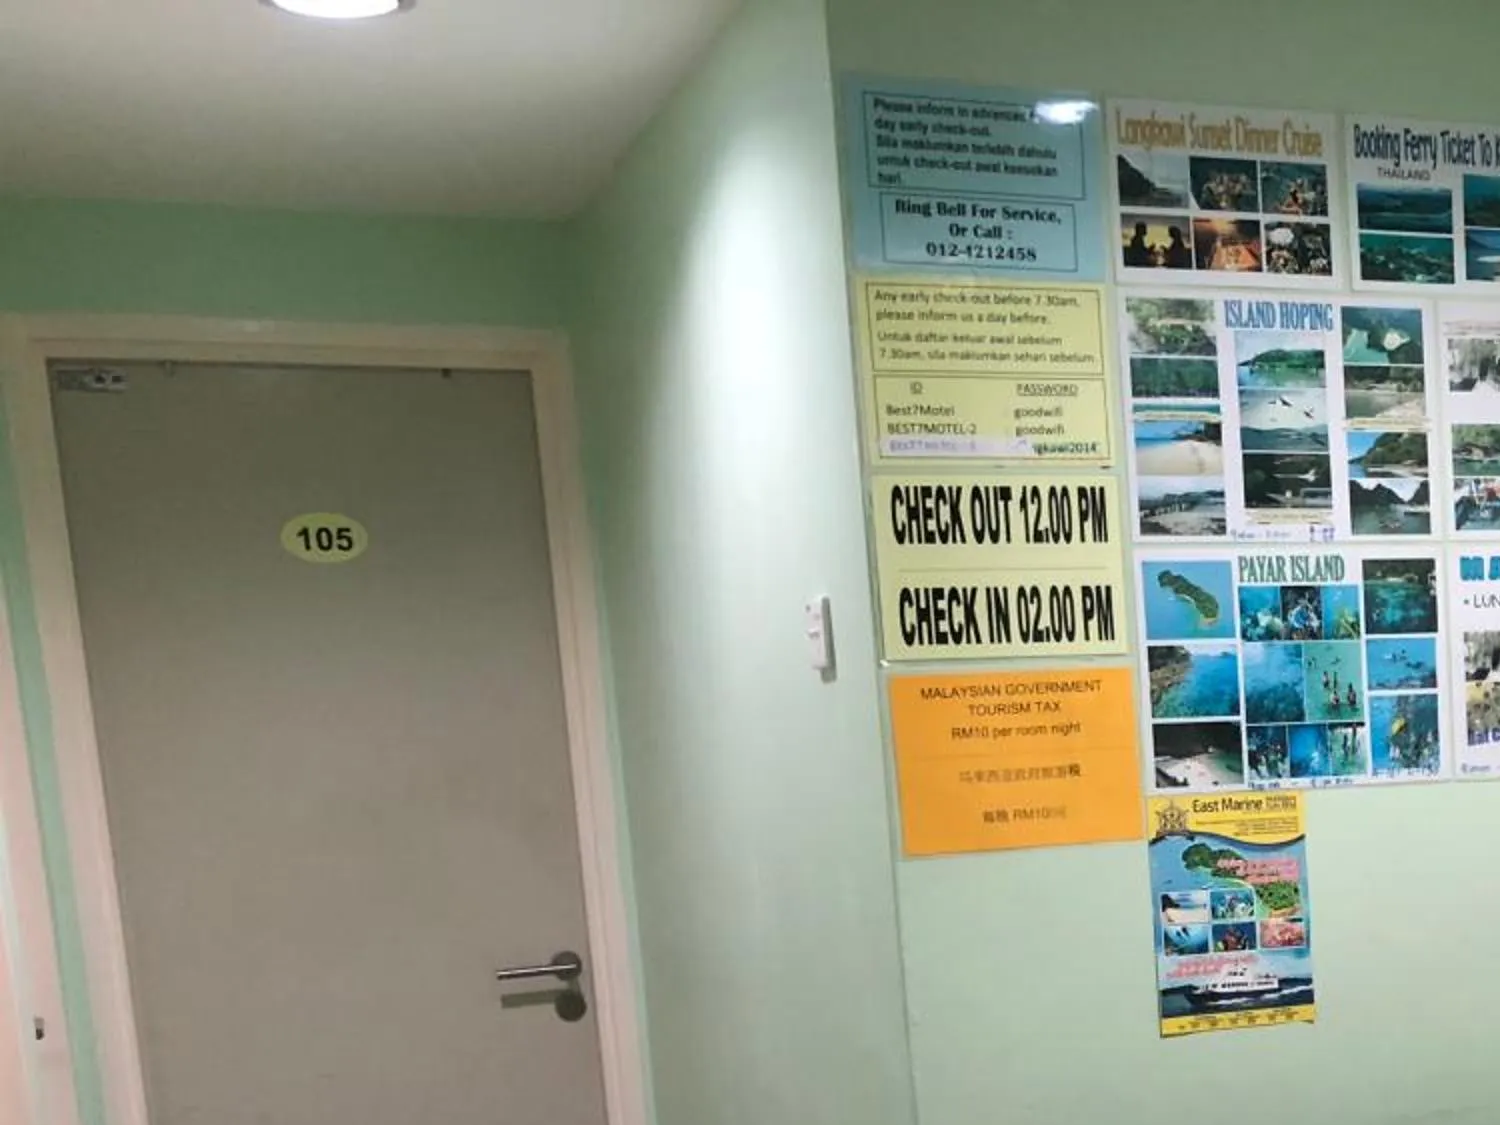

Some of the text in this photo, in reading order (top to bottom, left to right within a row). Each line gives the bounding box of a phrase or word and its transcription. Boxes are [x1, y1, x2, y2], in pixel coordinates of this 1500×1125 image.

[874, 98, 912, 113] Please
[917, 102, 954, 116] inform
[874, 118, 896, 132] day
[899, 121, 929, 135] early
[1353, 124, 1400, 166] Booking
[1403, 128, 1438, 170] Ferry
[1440, 131, 1476, 166] Ticket
[1478, 134, 1493, 167] To
[1377, 167, 1431, 181] THAILAND
[895, 199, 1061, 224] Ring Bell For Service,
[949, 223, 968, 238] Or
[875, 290, 897, 304] Any
[900, 292, 930, 306] early
[994, 294, 1031, 306] before
[876, 308, 914, 321] please
[917, 310, 957, 322] inform
[961, 313, 974, 323] us
[987, 312, 1007, 326] day
[1224, 300, 1333, 331] ISLAND HOPING
[877, 331, 912, 343] Untuk
[1017, 333, 1062, 345] sebelum
[891, 484, 1109, 545] CHECK OUT 12.00 PM
[296, 526, 353, 552] 105
[1238, 554, 1345, 583] PAYAR ISLAND
[899, 584, 1115, 646] CHECK IN 02.00 PM
[920, 679, 1102, 700] MALAYSIAN GOVERNMENT
[968, 700, 1061, 716] TOURISM TAX
[951, 722, 1080, 741] RM10 per room night
[1192, 799, 1219, 813] East
[1221, 797, 1264, 812] Marine
